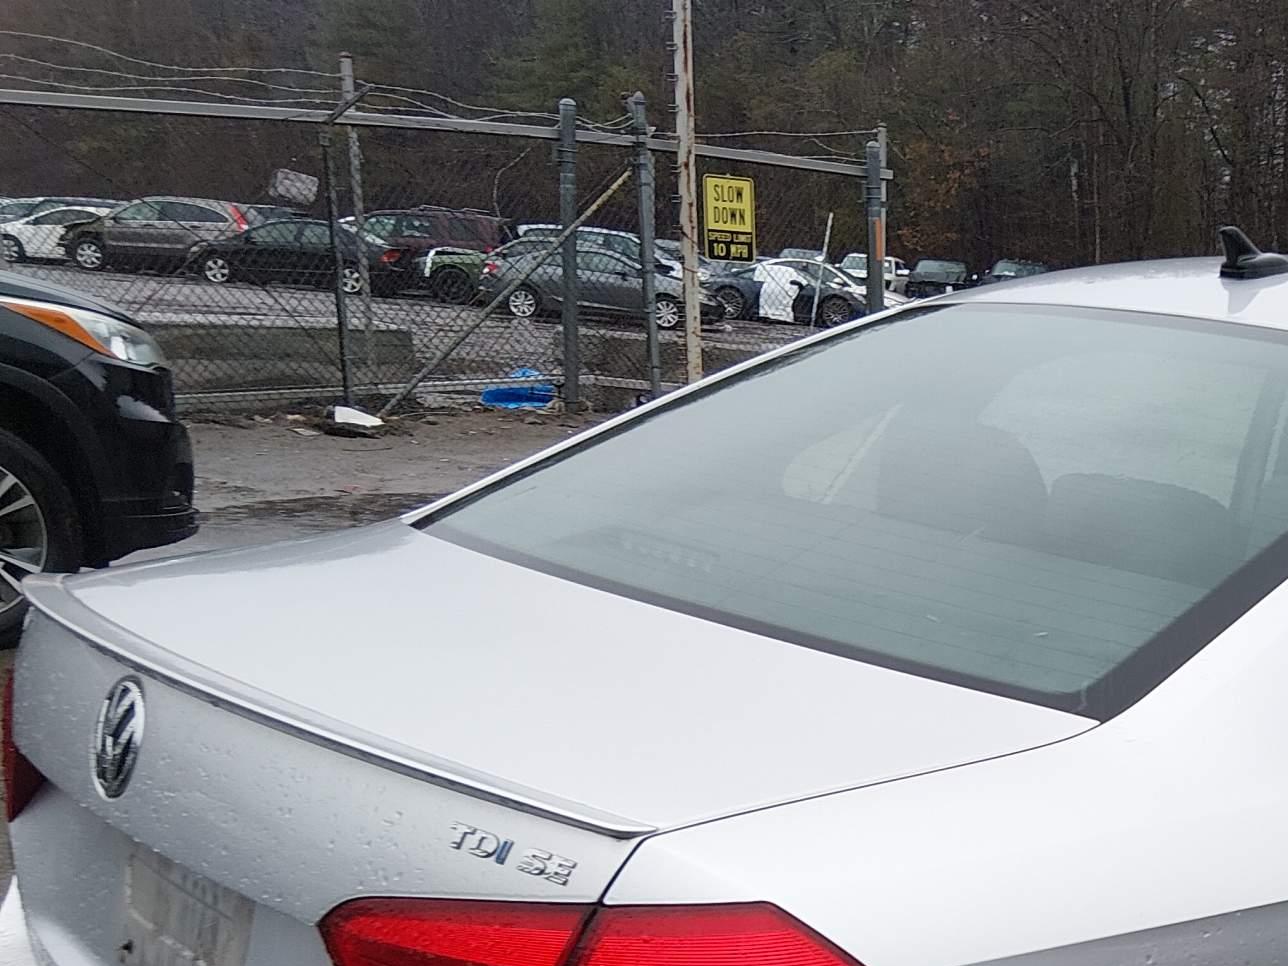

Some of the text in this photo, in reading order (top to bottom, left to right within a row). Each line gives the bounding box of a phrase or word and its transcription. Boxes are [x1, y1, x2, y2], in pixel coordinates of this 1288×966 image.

[713, 184, 744, 203] SLOW
[713, 206, 746, 226] DOWN
[713, 243, 727, 257] 10
[449, 820, 578, 887] TDI SE
